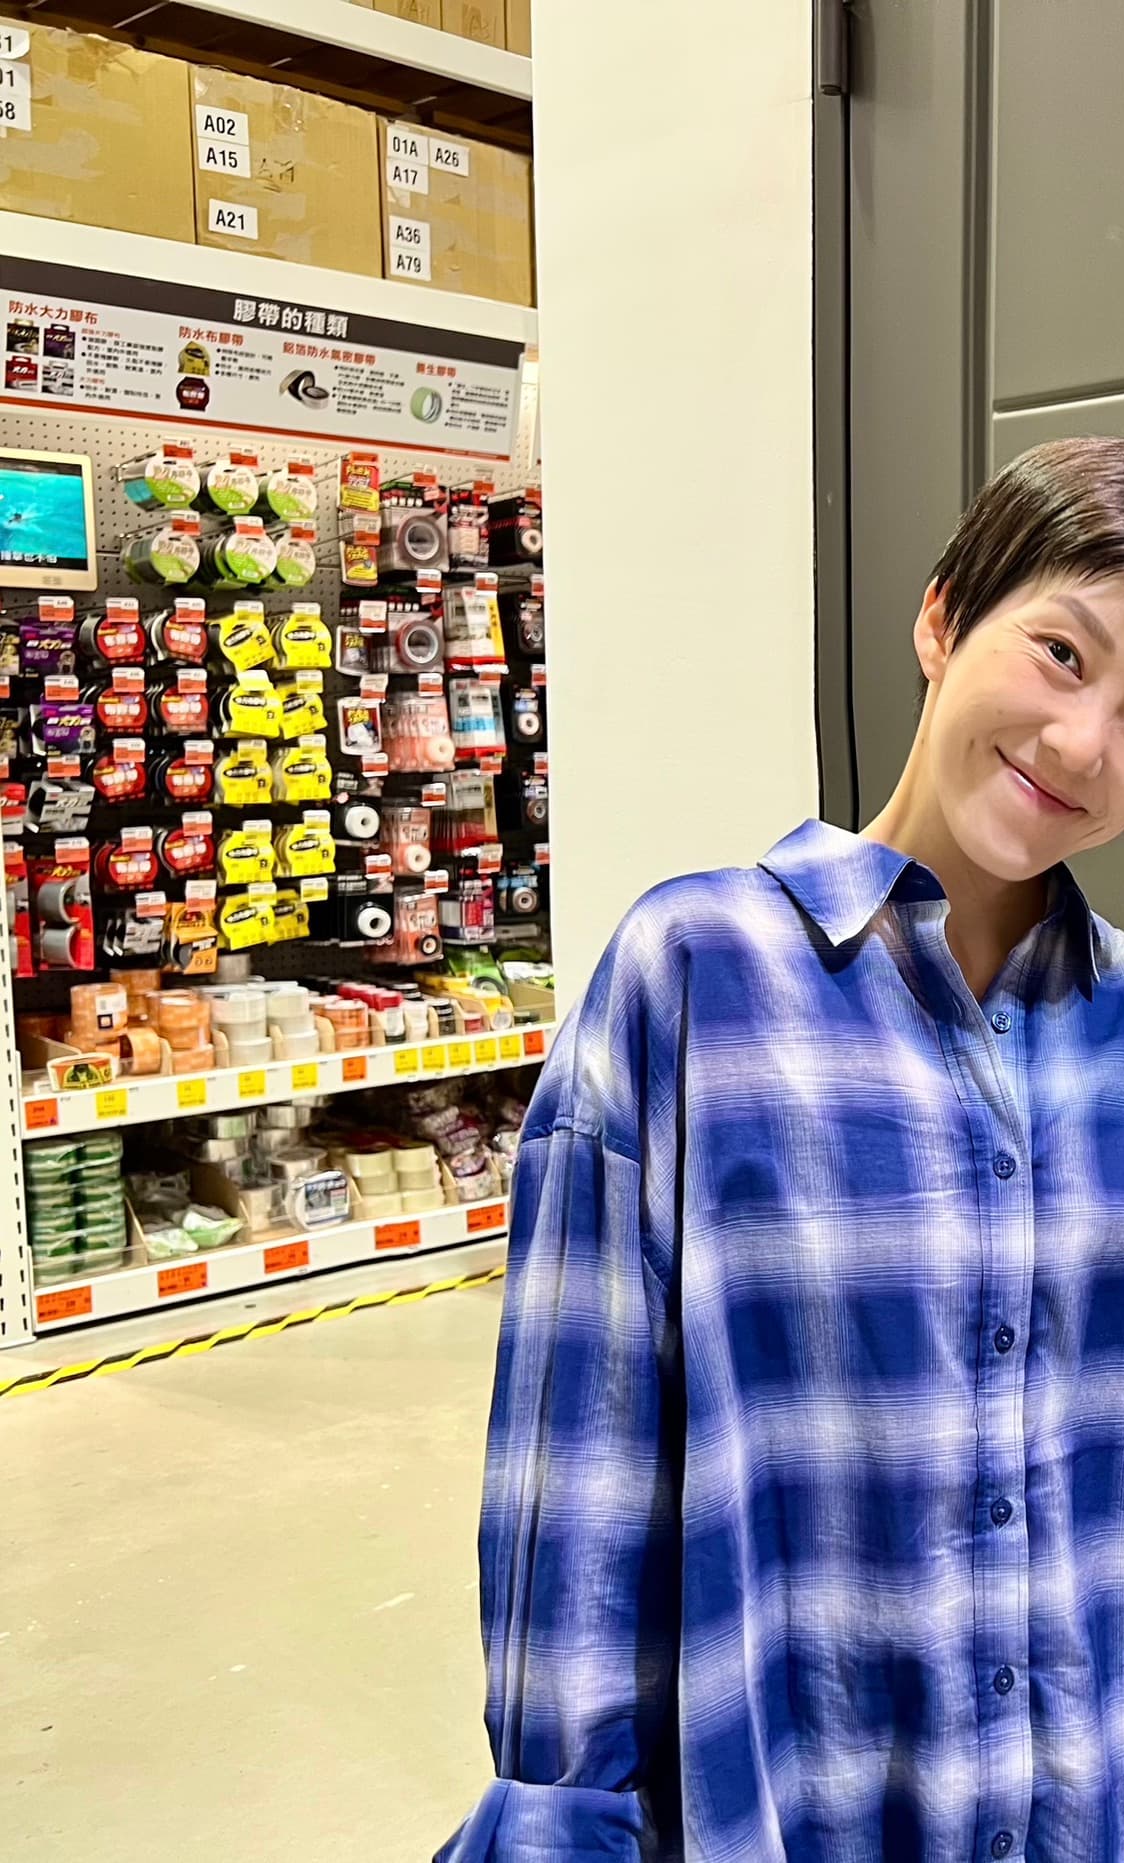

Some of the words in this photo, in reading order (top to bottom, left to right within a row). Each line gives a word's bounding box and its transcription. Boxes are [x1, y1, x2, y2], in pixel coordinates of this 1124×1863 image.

[204, 114, 236, 136] A02
[392, 136, 418, 157] 01A
[206, 147, 238, 168] A15
[435, 148, 460, 167] A26
[393, 166, 419, 185] A17
[216, 209, 244, 230] A21
[396, 225, 421, 244] A36
[396, 254, 421, 273] A79
[8, 300, 98, 325] 防水大力膠布
[233, 299, 349, 338] 膠帶的種類
[179, 326, 244, 346] 防水布膠帶
